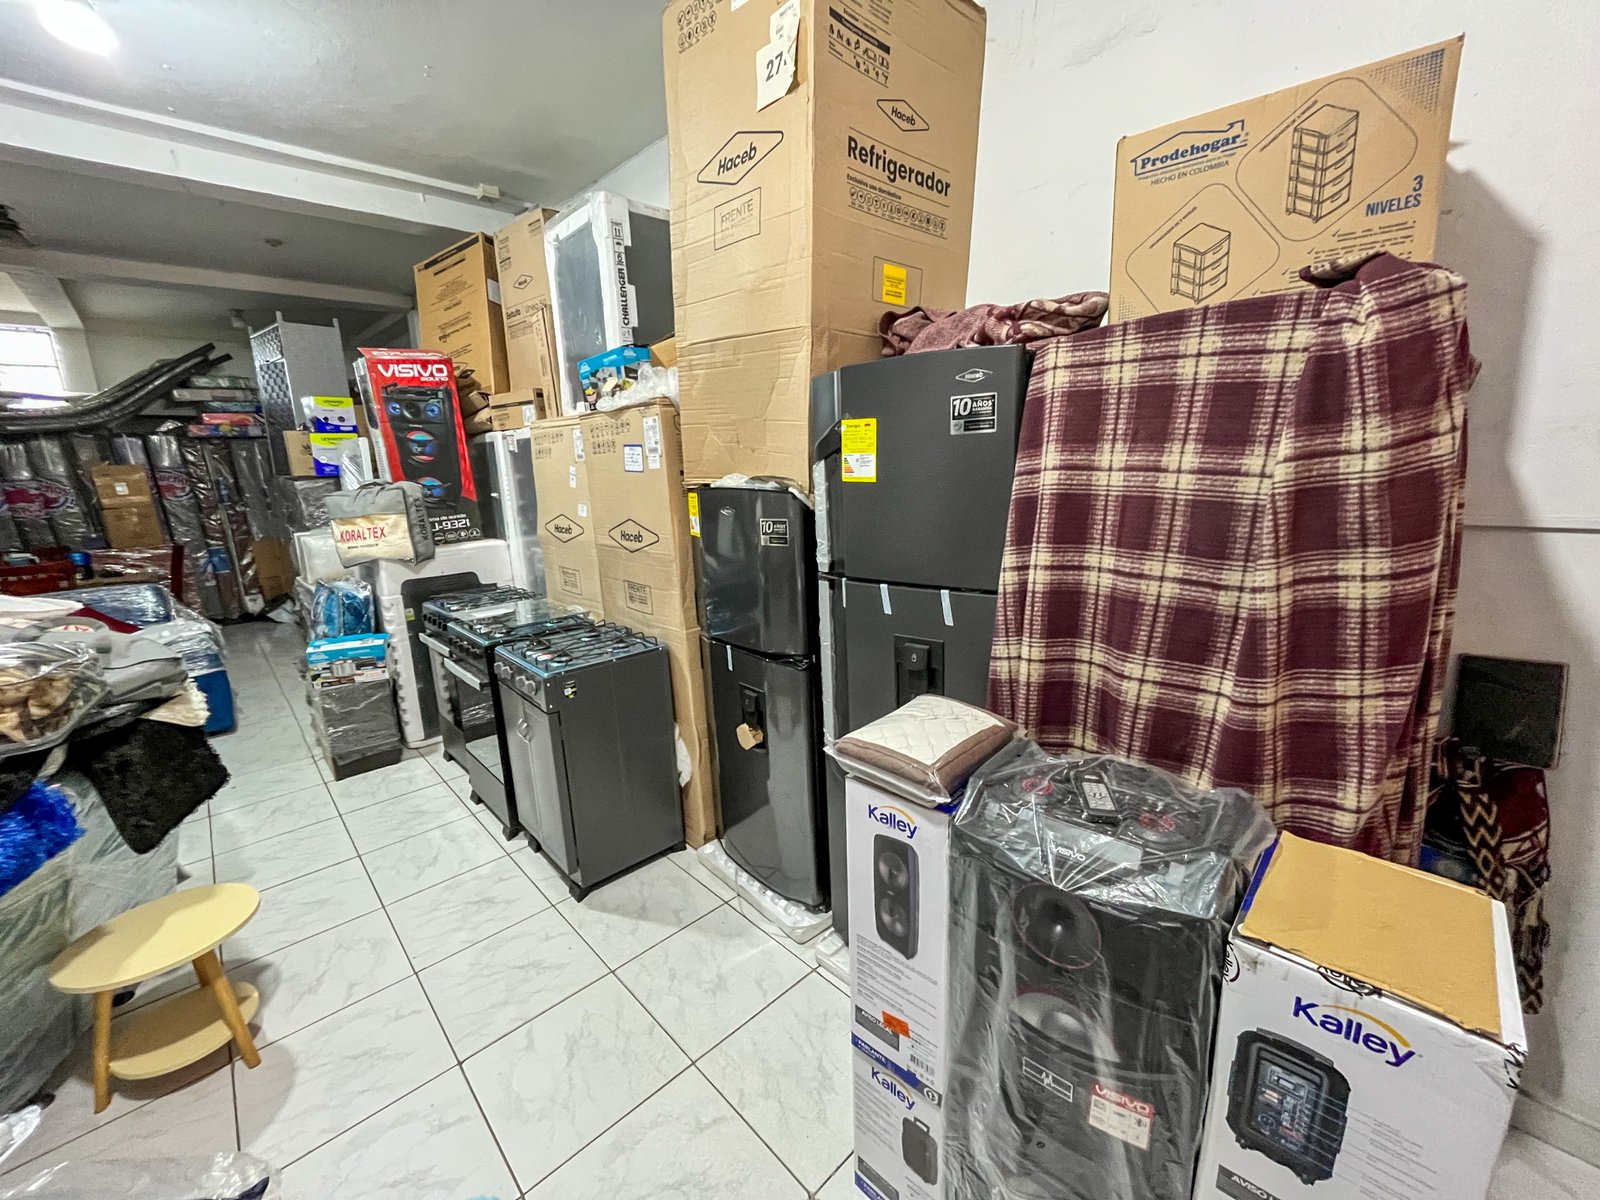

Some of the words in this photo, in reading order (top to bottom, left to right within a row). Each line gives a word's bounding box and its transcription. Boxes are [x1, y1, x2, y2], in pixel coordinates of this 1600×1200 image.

[891, 106, 916, 126] Haceb
[717, 141, 757, 176] Haceb
[1140, 134, 1241, 170] Prodehogar
[847, 135, 951, 197] Refrigerador
[1150, 174, 1177, 186] HECHO
[1177, 170, 1188, 179] EN
[1188, 160, 1230, 176] COLOMBIA
[1412, 175, 1424, 193] 3
[720, 198, 754, 229] FRENTE
[1365, 193, 1422, 217] NIVELES
[617, 267, 630, 326] CHALLENGER
[377, 363, 448, 378] VISIVO
[953, 397, 972, 417] 10
[339, 526, 387, 543] KORALTEX
[554, 523, 573, 535] Haceb
[620, 529, 644, 543] Haceb
[762, 521, 774, 534] 10
[868, 804, 918, 839] Kalley
[1292, 996, 1416, 1067] Kalley
[871, 1066, 916, 1111] Kalley
[1095, 1084, 1150, 1114] VISIVO
[1231, 1175, 1268, 1200] AVISO
